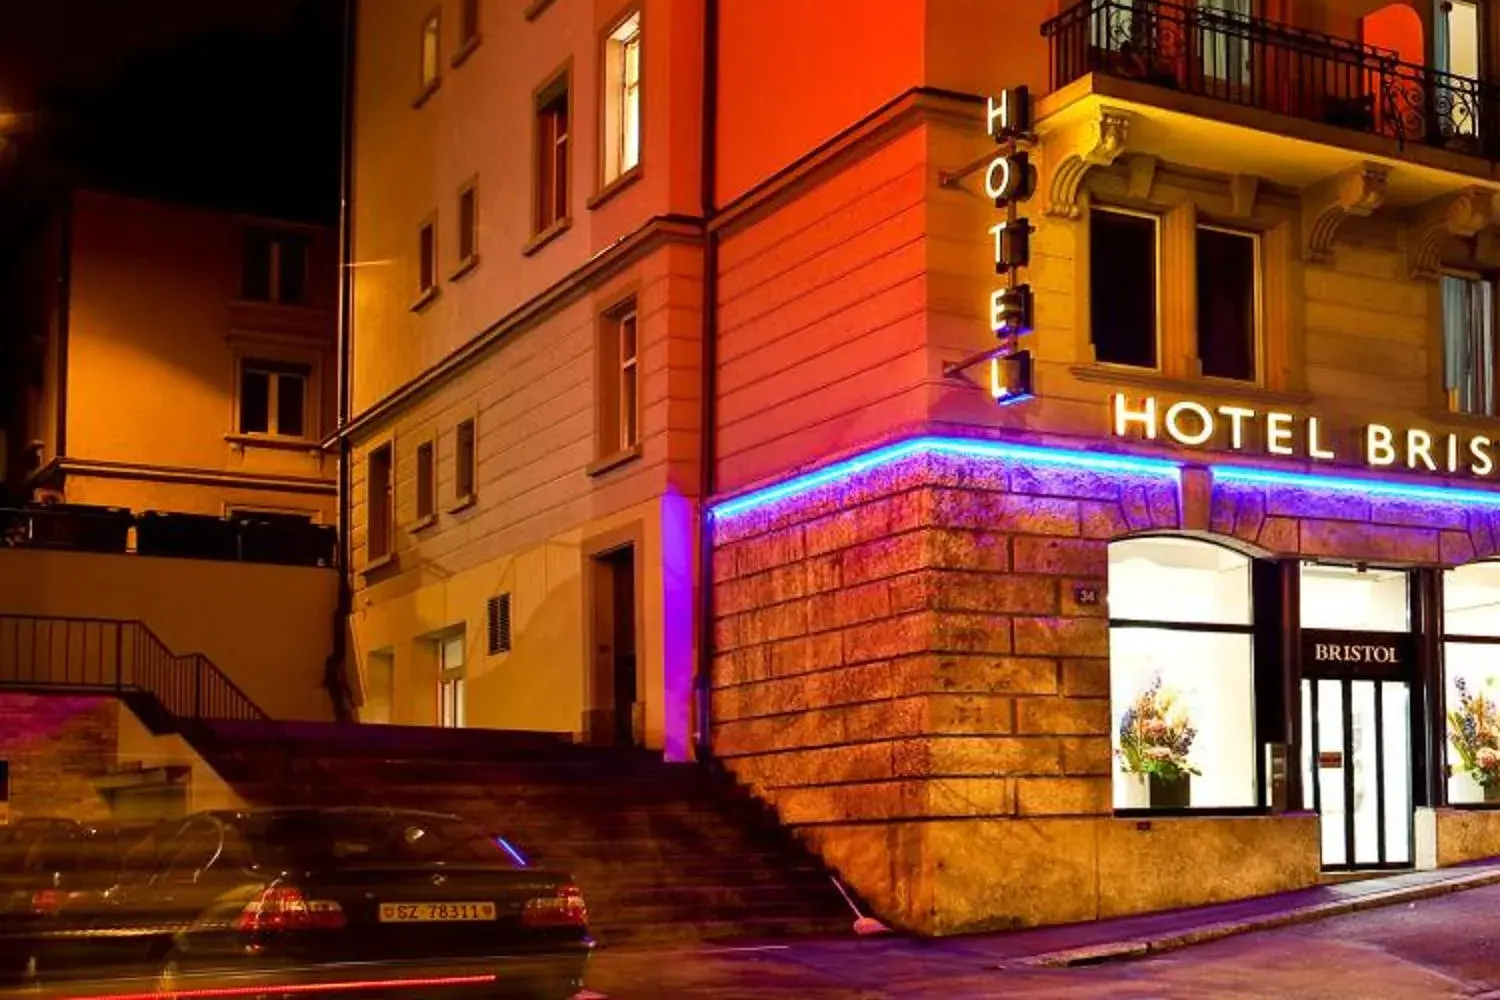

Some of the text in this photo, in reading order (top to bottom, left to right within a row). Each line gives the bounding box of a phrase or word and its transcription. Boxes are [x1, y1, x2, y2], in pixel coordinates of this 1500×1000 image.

[1113, 392, 1335, 460] HOTEL
[1314, 643, 1402, 664] BRISTOL
[397, 904, 420, 920] SZ
